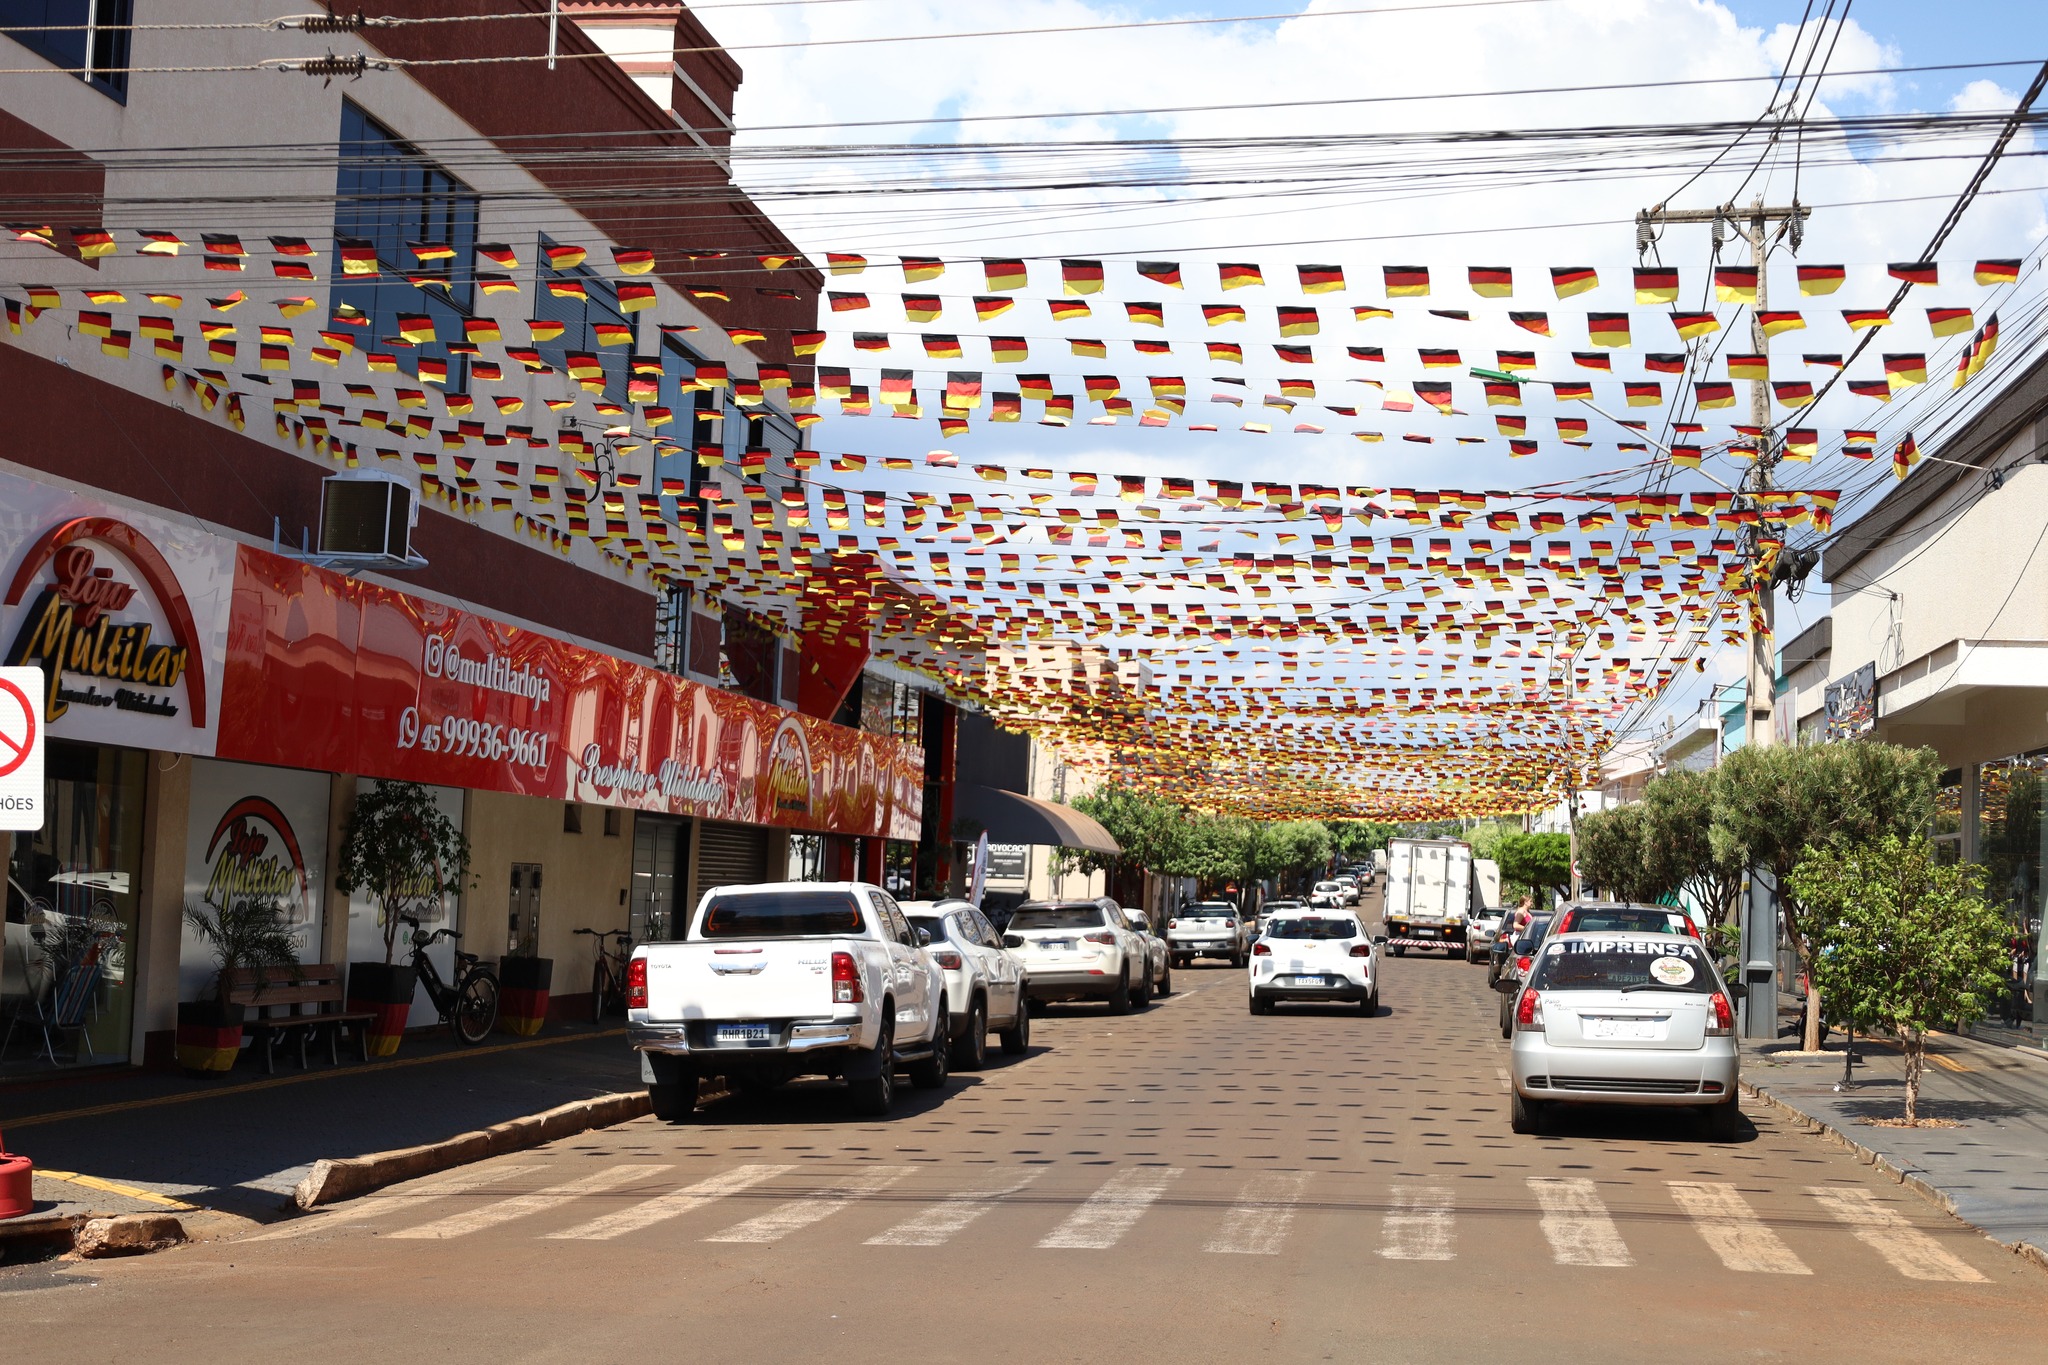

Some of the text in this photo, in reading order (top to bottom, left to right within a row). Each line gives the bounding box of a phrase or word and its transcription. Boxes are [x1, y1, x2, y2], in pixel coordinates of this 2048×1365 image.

[47, 545, 138, 628] Loja
[6, 591, 187, 723] Multilar
[444, 645, 550, 711] @multilarloja
[420, 715, 548, 768] 45 99936-9661
[578, 743, 646, 791] Presentes
[660, 758, 722, 802] Utilidades
[230, 816, 268, 868] Loja
[205, 842, 296, 922] Multilar
[1571, 941, 1698, 959] IMPRENSA
[722, 1029, 764, 1039] RHR1B21
